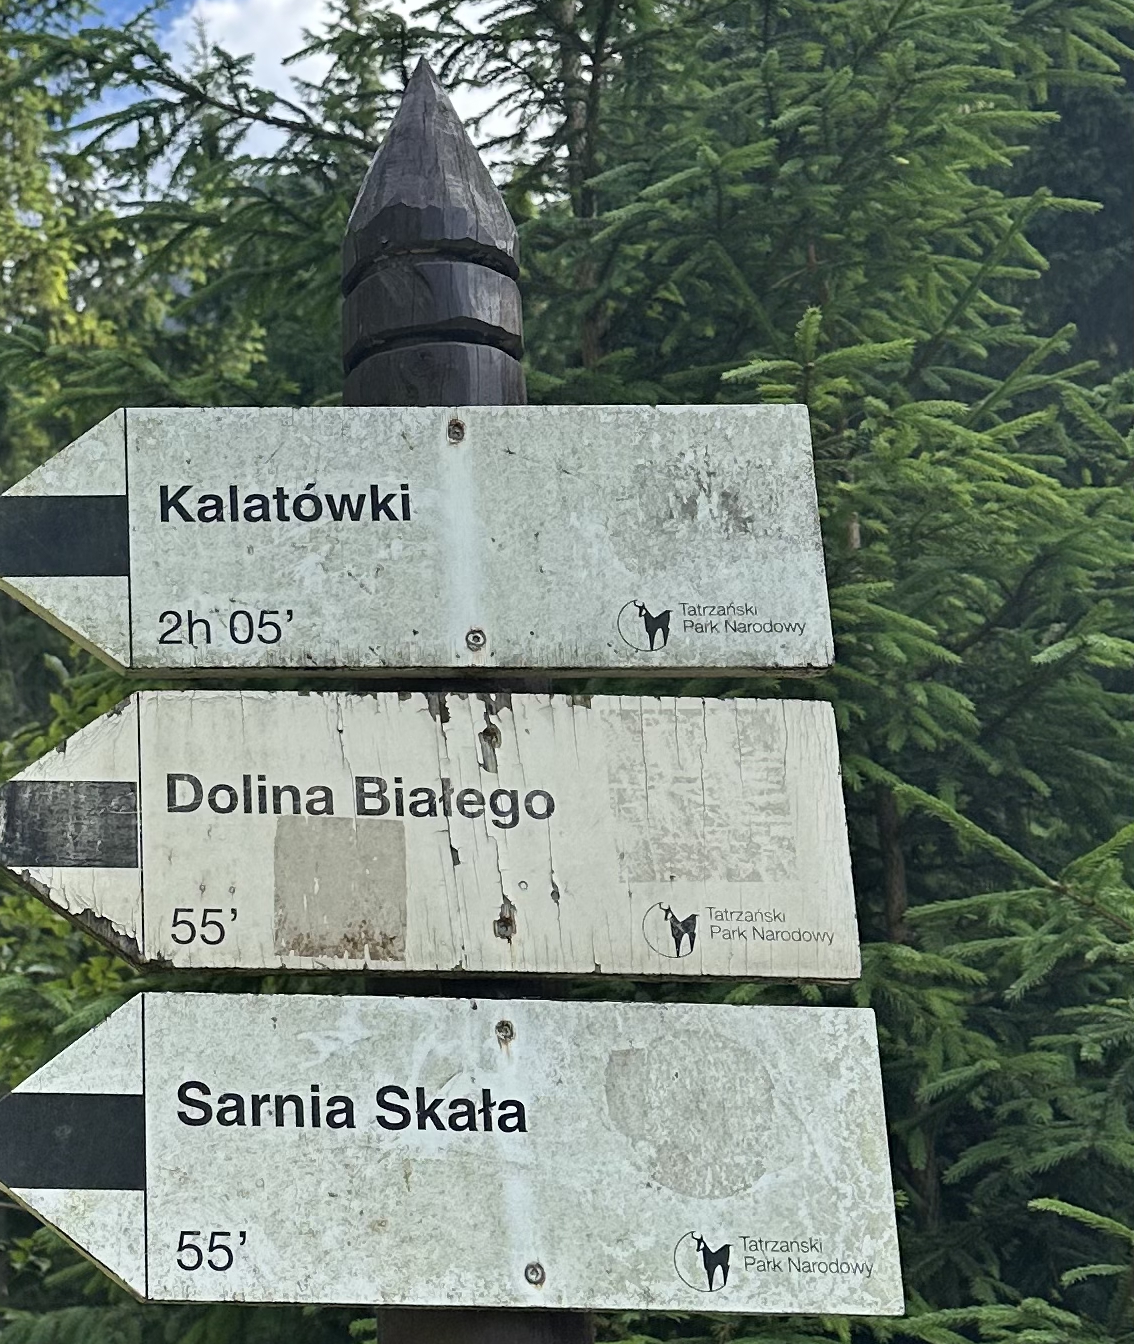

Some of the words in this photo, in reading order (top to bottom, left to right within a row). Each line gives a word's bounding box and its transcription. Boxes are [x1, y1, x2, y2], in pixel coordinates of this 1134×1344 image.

[159, 483, 411, 523] Kalatówki
[158, 609, 212, 645] 2h
[229, 609, 293, 645] 05'
[678, 601, 758, 617] Tatrzański
[683, 619, 720, 633] Park
[724, 618, 806, 636] Narodowy
[166, 773, 334, 817] Dolina
[354, 775, 556, 829] Białego
[170, 907, 238, 946] 55'
[705, 906, 786, 923] Tatrzański
[710, 925, 747, 940] Park
[752, 926, 834, 946] Narodowy
[176, 1080, 356, 1129] Sarnia
[376, 1085, 528, 1133] Skała
[176, 1230, 247, 1272] 55'
[744, 1256, 783, 1272] Park
[787, 1257, 874, 1278] Narodowy
